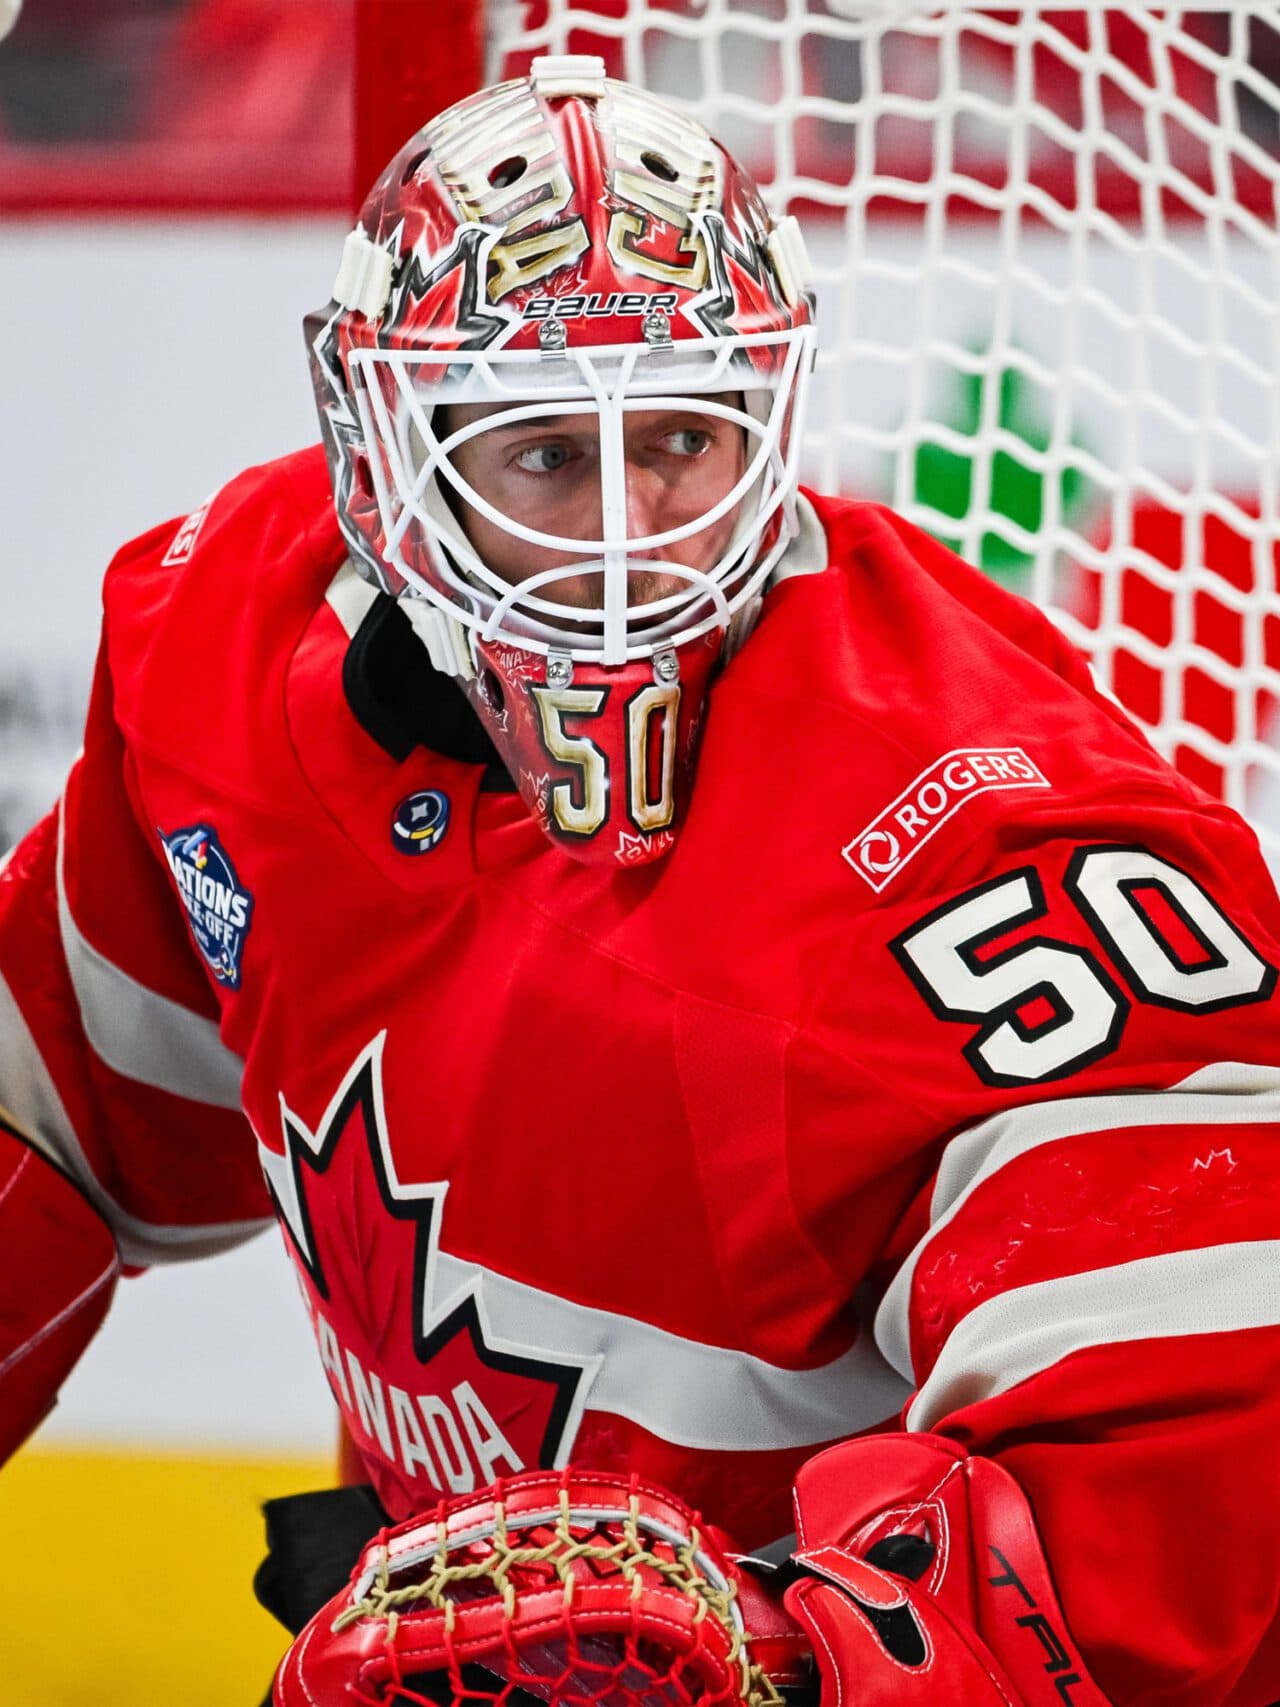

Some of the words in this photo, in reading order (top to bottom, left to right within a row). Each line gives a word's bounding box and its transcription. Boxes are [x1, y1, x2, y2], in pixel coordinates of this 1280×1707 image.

[531, 685, 682, 838] 50
[894, 753, 1037, 838] ROGERS
[887, 843, 1279, 1088] 50
[297, 1262, 525, 1495] ANADA
